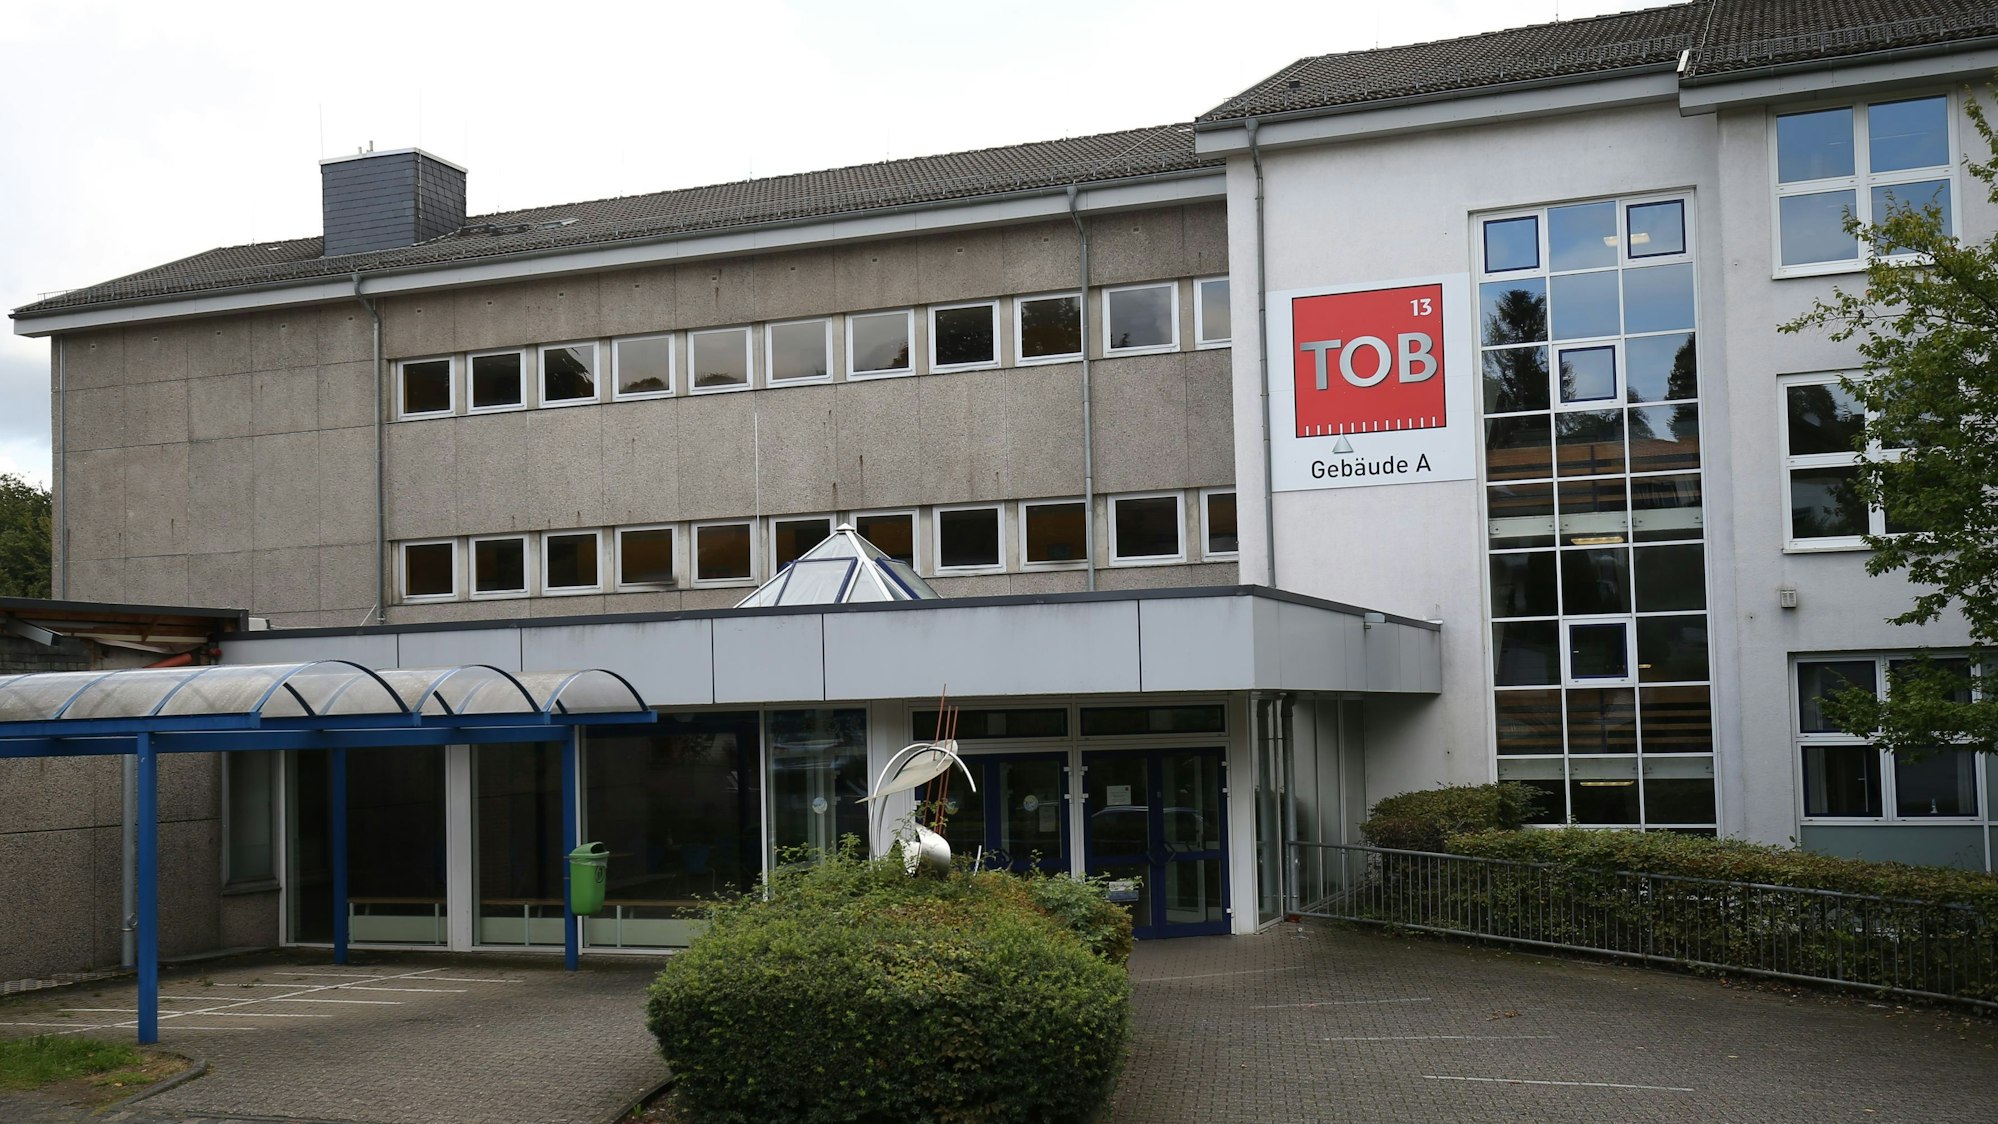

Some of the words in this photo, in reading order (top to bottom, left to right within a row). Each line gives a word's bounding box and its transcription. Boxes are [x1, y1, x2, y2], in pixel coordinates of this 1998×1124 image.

[1410, 298, 1433, 316] 13
[1300, 332, 1438, 390] TOB
[1311, 456, 1409, 479] Gebäude
[1416, 454, 1431, 472] A
